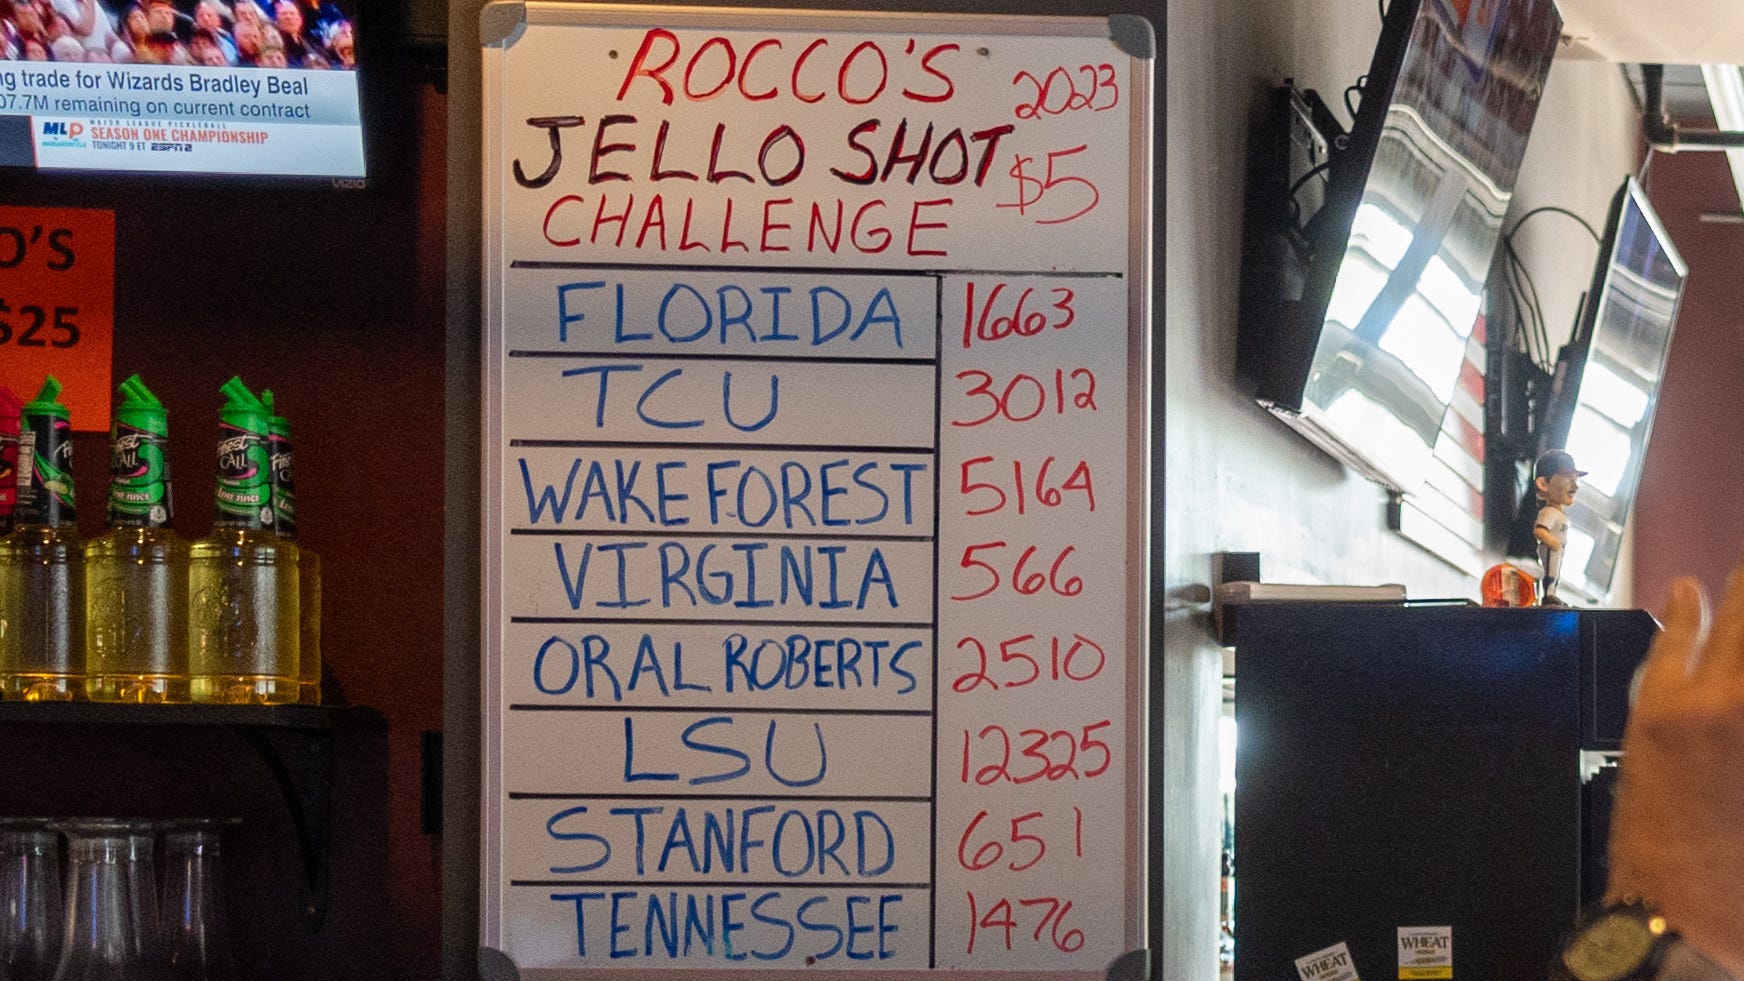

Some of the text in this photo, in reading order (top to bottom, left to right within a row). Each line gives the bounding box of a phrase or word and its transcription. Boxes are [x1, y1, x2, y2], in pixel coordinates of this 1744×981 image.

[21, 69, 70, 88] trade
[75, 70, 102, 88] for
[107, 71, 184, 92] Wizards
[190, 73, 261, 98] Bradley
[267, 76, 308, 95] Beal
[616, 28, 961, 106] ROCCO'S
[1012, 63, 1119, 121] 2023
[55, 97, 141, 117] remaining
[146, 101, 168, 114] on
[174, 102, 235, 116] current
[240, 103, 311, 118] contract
[90, 126, 268, 144] SEASON ONE CHAMPIONSHIP
[92, 140, 127, 150] TONIGHT
[513, 114, 1016, 189] JELLO SHOT
[996, 144, 1101, 225] $5
[542, 193, 954, 257] CHALLENGE
[557, 280, 904, 348] FLORIDA
[962, 281, 1075, 349] 1663
[562, 363, 779, 433] TCU
[951, 367, 1097, 429] 3012
[518, 457, 928, 529] WAKE FOREST
[959, 456, 1096, 516] 5164
[554, 541, 900, 611] VIRGINIA
[951, 541, 1084, 602] 566
[533, 633, 923, 702] ORAL ROBERTS
[951, 632, 1105, 695] 2510
[623, 716, 828, 787] LSU
[961, 719, 1112, 788] 12325
[545, 804, 894, 877] STANFORD
[958, 806, 1083, 872] 651
[550, 891, 904, 962] TENNESSEE
[965, 891, 1085, 955] 1476
[1401, 935, 1449, 950] WHEAT
[1301, 952, 1348, 980] WHEAT
